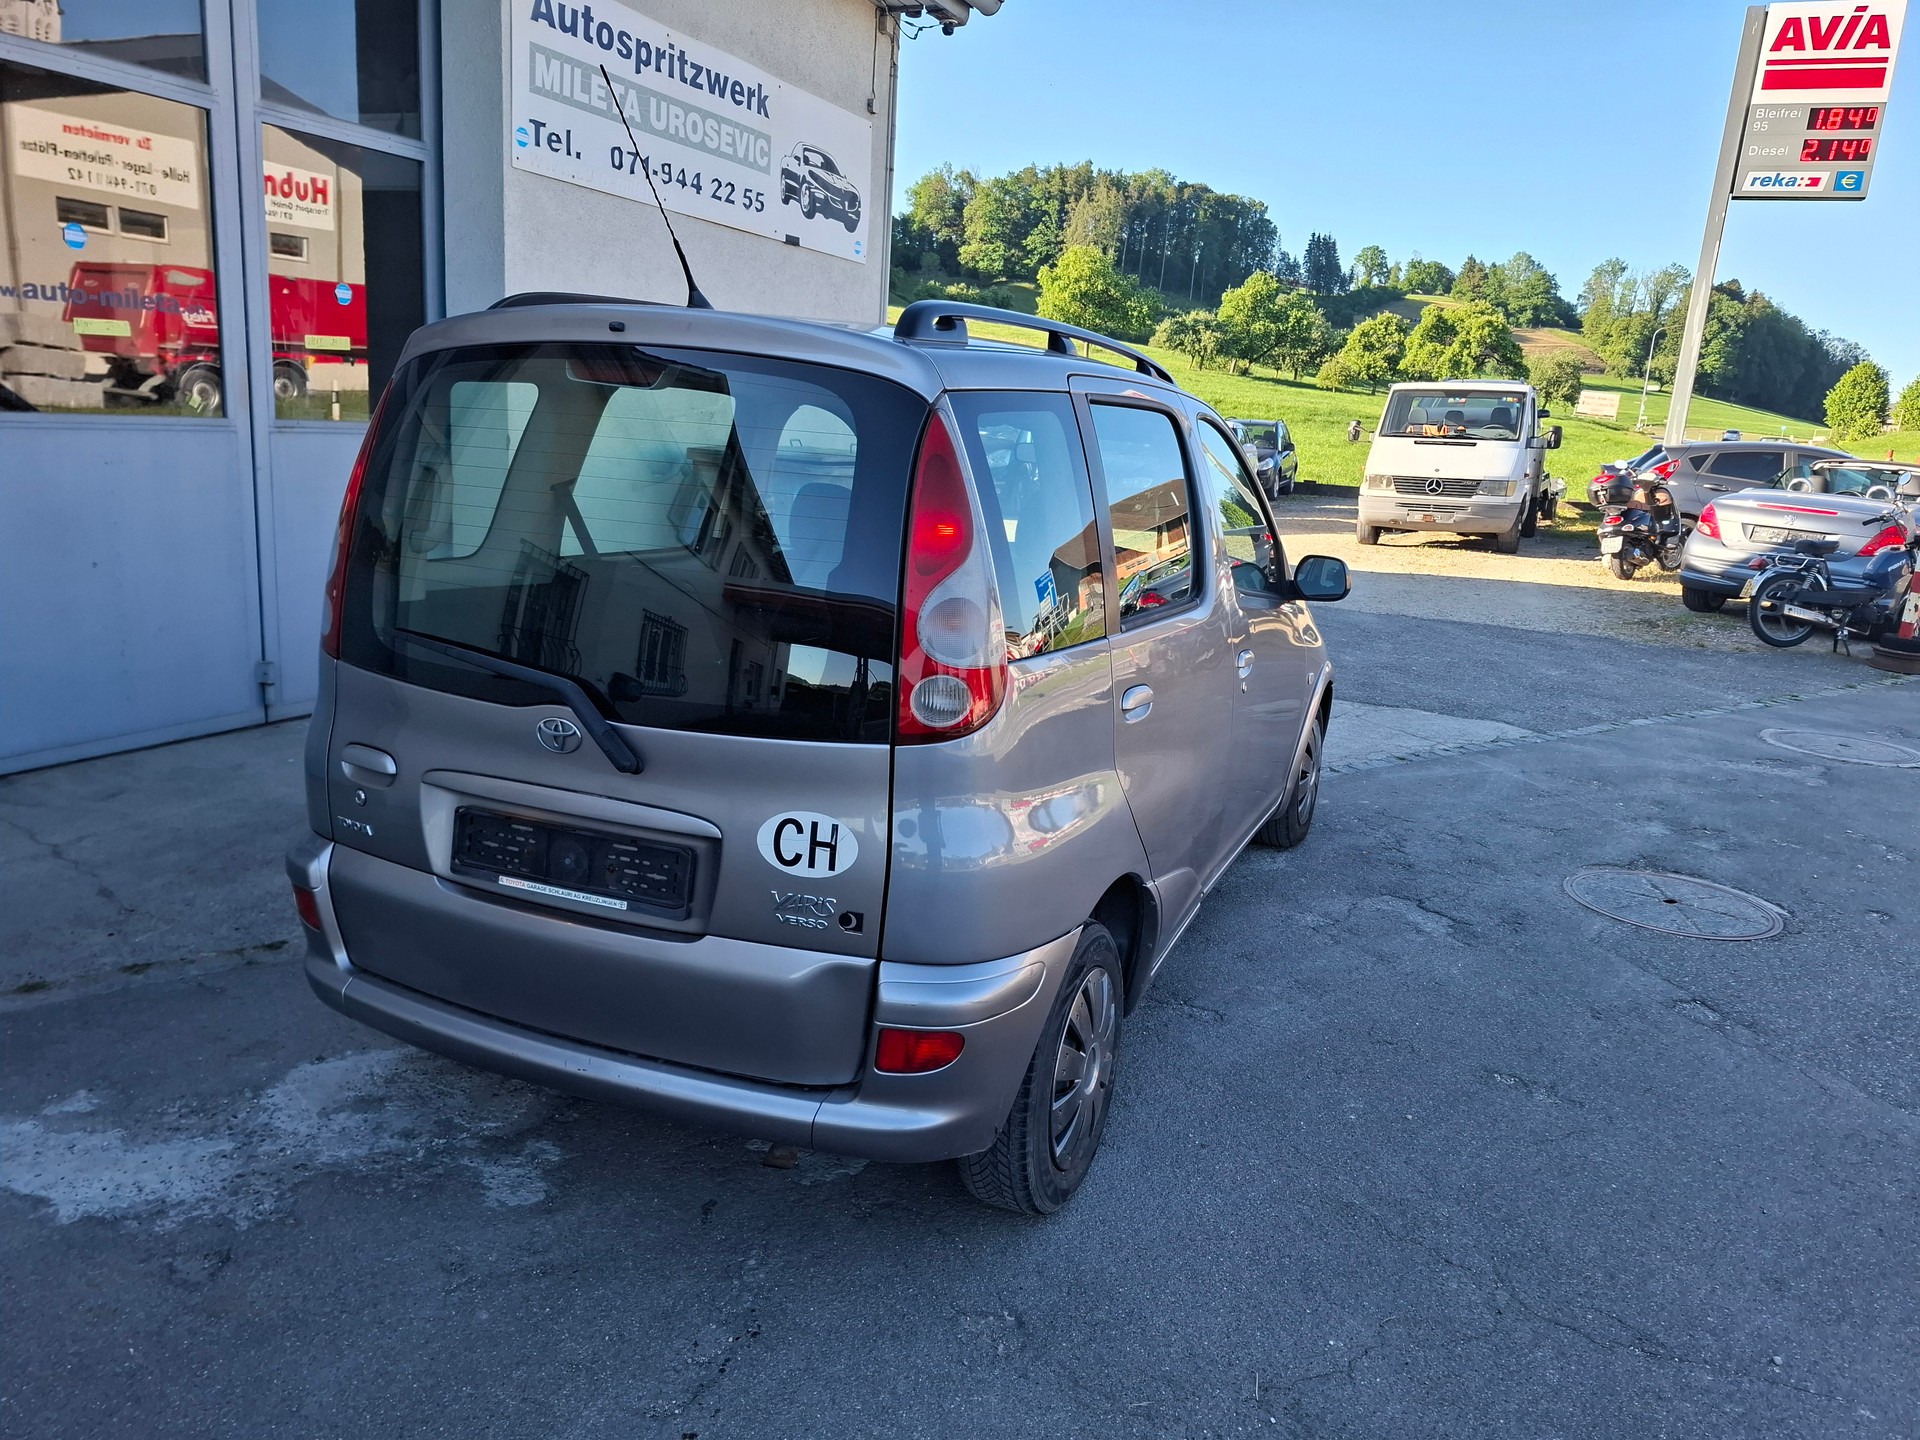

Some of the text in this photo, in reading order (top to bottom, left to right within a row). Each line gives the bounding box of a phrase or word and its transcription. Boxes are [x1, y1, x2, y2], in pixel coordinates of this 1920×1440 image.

[1769, 5, 1891, 51] AVIA
[530, 0, 770, 119] Autospritzwerk
[535, 51, 769, 168] MILETA UROSEVIC
[1755, 107, 1802, 119] Bleifrei
[1753, 121, 1768, 131] 95
[1748, 145, 1789, 156] Diesel
[529, 118, 581, 160] Tel.
[711, 177, 735, 206] 22
[743, 187, 765, 213] 55
[773, 817, 839, 872] CH
[505, 878, 526, 888] TOYOTA
[526, 883, 547, 892] GARAGE
[770, 890, 837, 917] YARIS
[775, 913, 828, 929] VERSO
